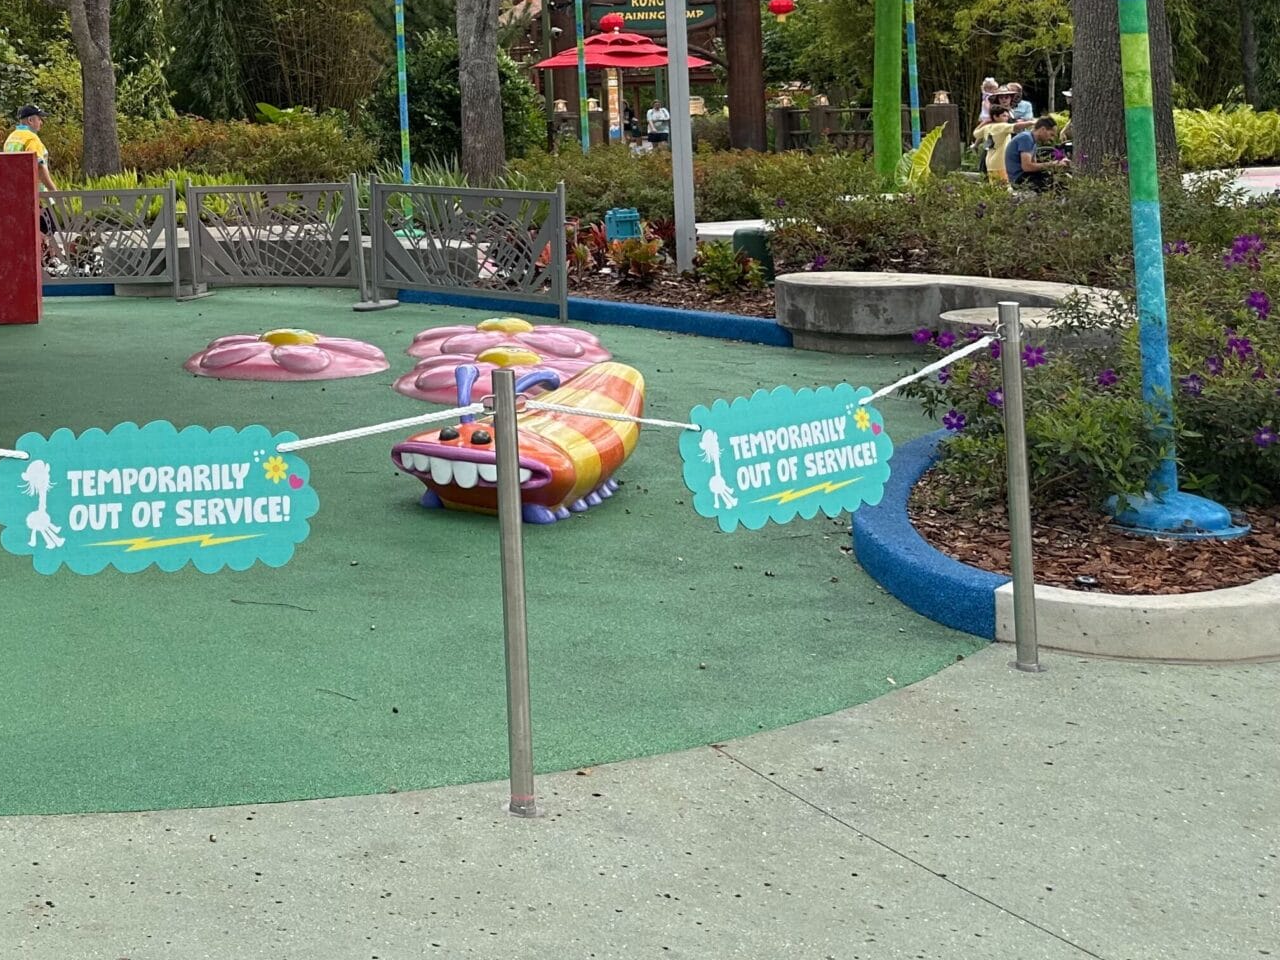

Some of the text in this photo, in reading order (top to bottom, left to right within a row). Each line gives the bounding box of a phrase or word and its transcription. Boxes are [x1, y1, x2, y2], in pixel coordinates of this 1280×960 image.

[615, 10, 665, 20] RAINING
[729, 415, 846, 460] TEMPORARILY
[67, 462, 250, 497] TEMPORARILY
[736, 441, 878, 491] OUT OF SERVICE!
[69, 496, 291, 531] OUT OF SERVICE!
